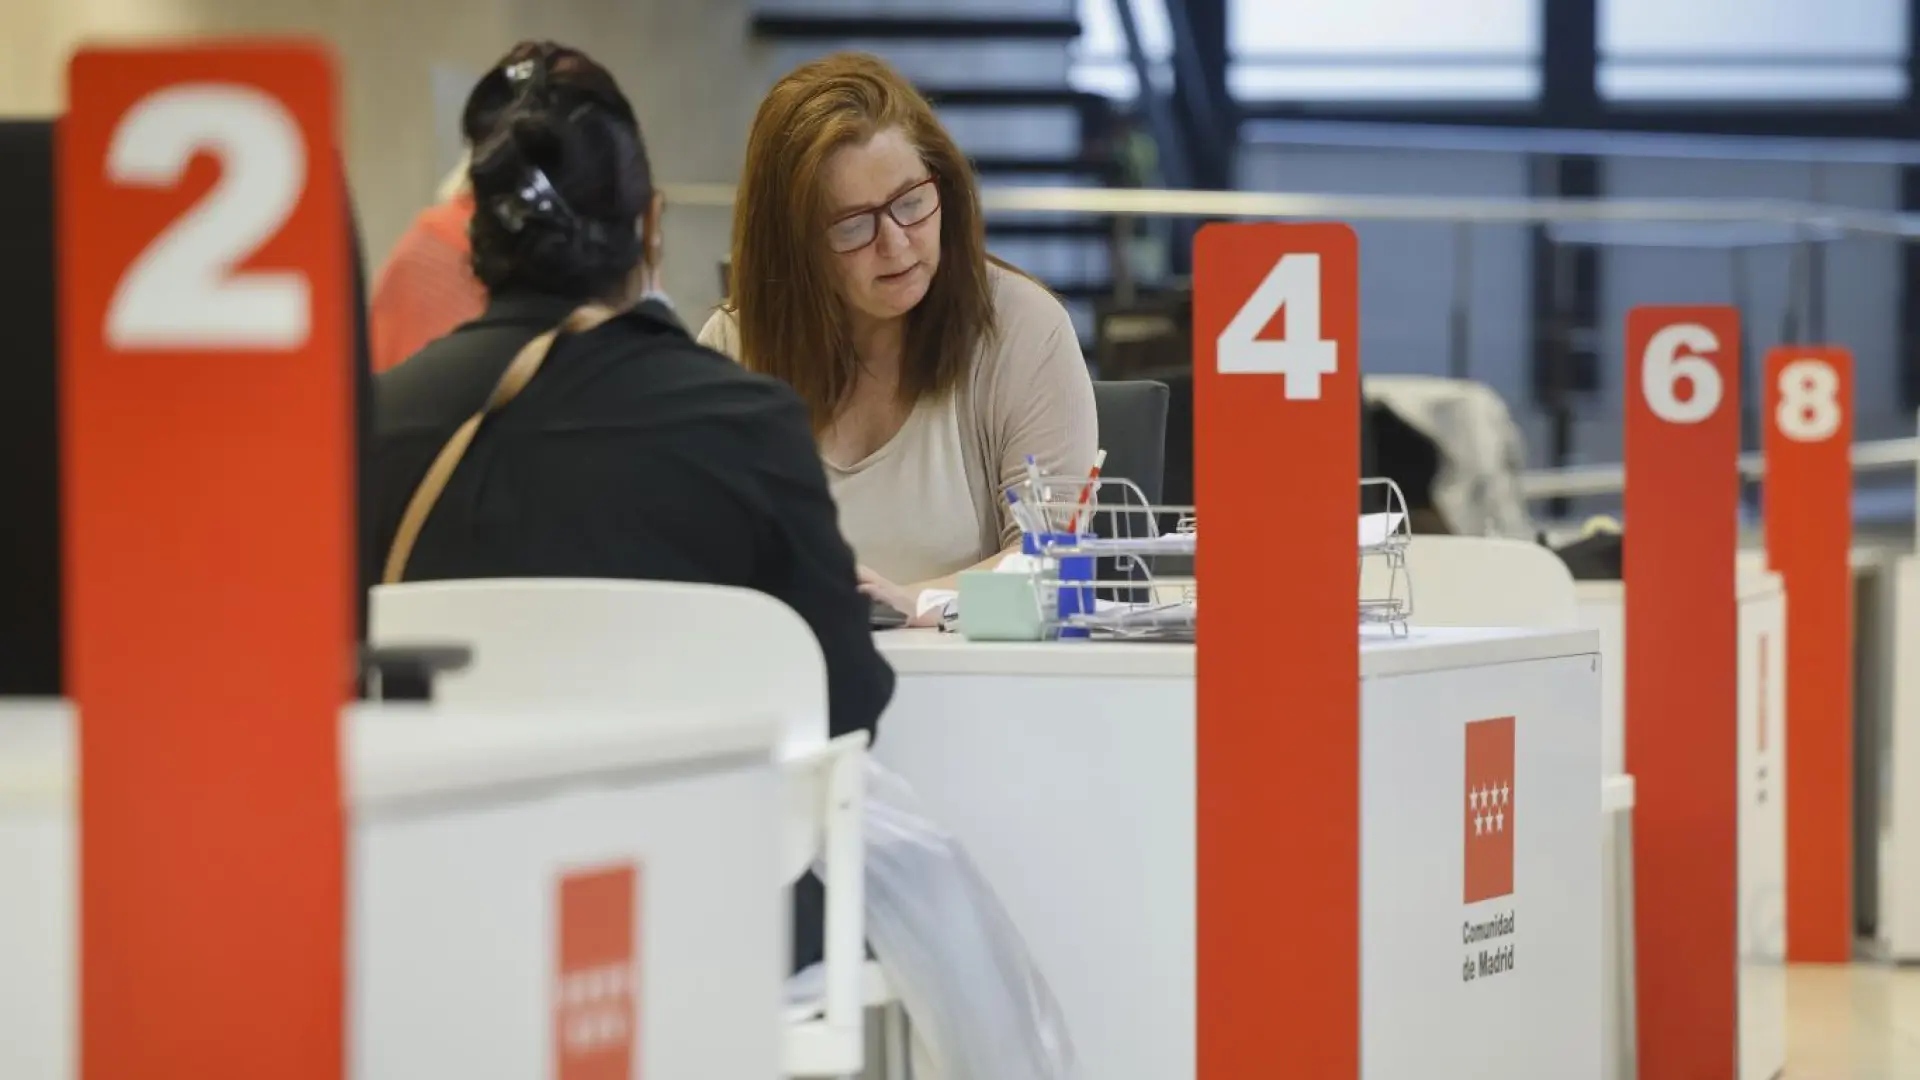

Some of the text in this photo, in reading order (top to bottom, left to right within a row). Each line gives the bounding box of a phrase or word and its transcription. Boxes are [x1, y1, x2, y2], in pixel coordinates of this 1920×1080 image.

[105, 84, 311, 351] 2
[1215, 252, 1339, 401] 4
[1641, 323, 1723, 423] 6
[1776, 359, 1841, 441] 8
[1462, 910, 1515, 945] Comunidad
[1462, 944, 1515, 982] de Madrid
